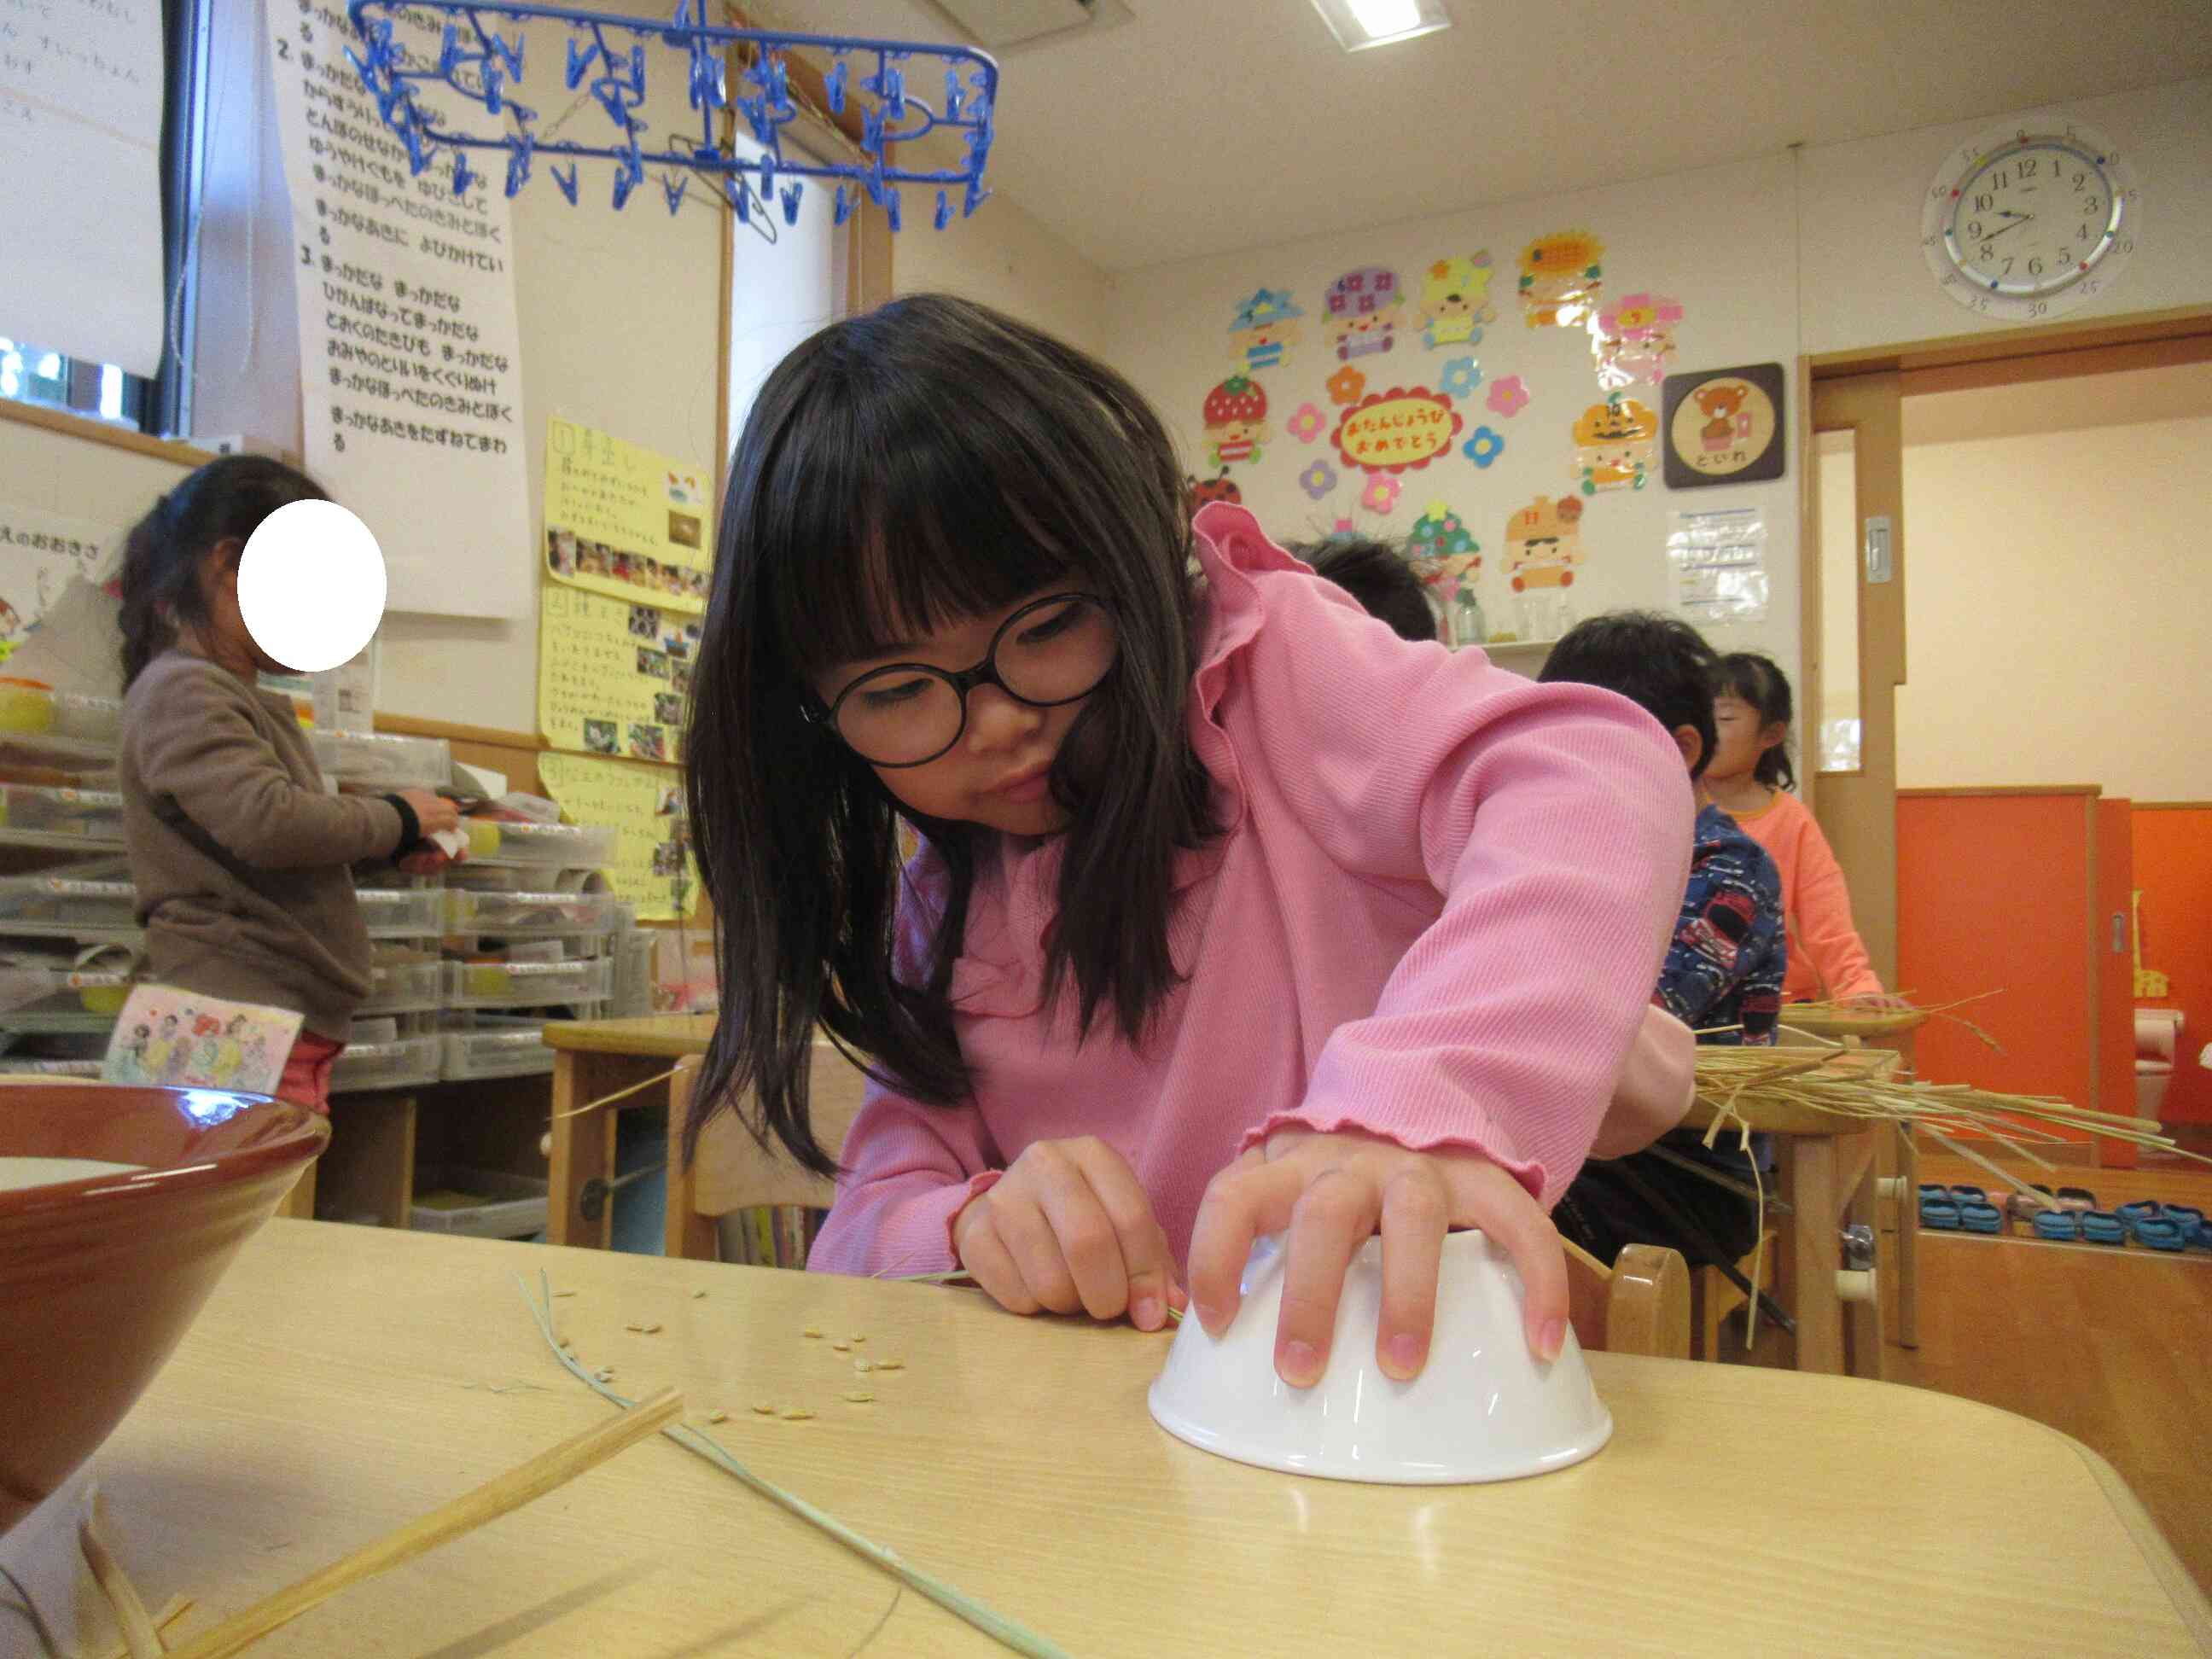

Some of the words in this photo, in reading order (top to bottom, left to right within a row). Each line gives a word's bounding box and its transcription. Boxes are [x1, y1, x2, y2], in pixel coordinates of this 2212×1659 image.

[2017, 159, 2037, 179] 12
[2052, 160, 2061, 178] 1
[1993, 171, 2007, 191] 11
[2072, 173, 2085, 191] 2
[1974, 193, 1994, 212] 10
[2084, 197, 2098, 214] 3
[1967, 220, 1982, 240] 9
[2075, 223, 2088, 241] 4
[1980, 242, 1994, 261] 8
[2056, 247, 2071, 265] 5
[2001, 257, 2015, 276] 7
[2028, 258, 2044, 276] 6
[321, 253, 383, 290] まっかだな
[393, 280, 461, 313] まっかだな
[441, 343, 509, 374] まっかだな
[1346, 407, 1445, 439] おたんじょうび
[1355, 430, 1437, 455] おめでとう
